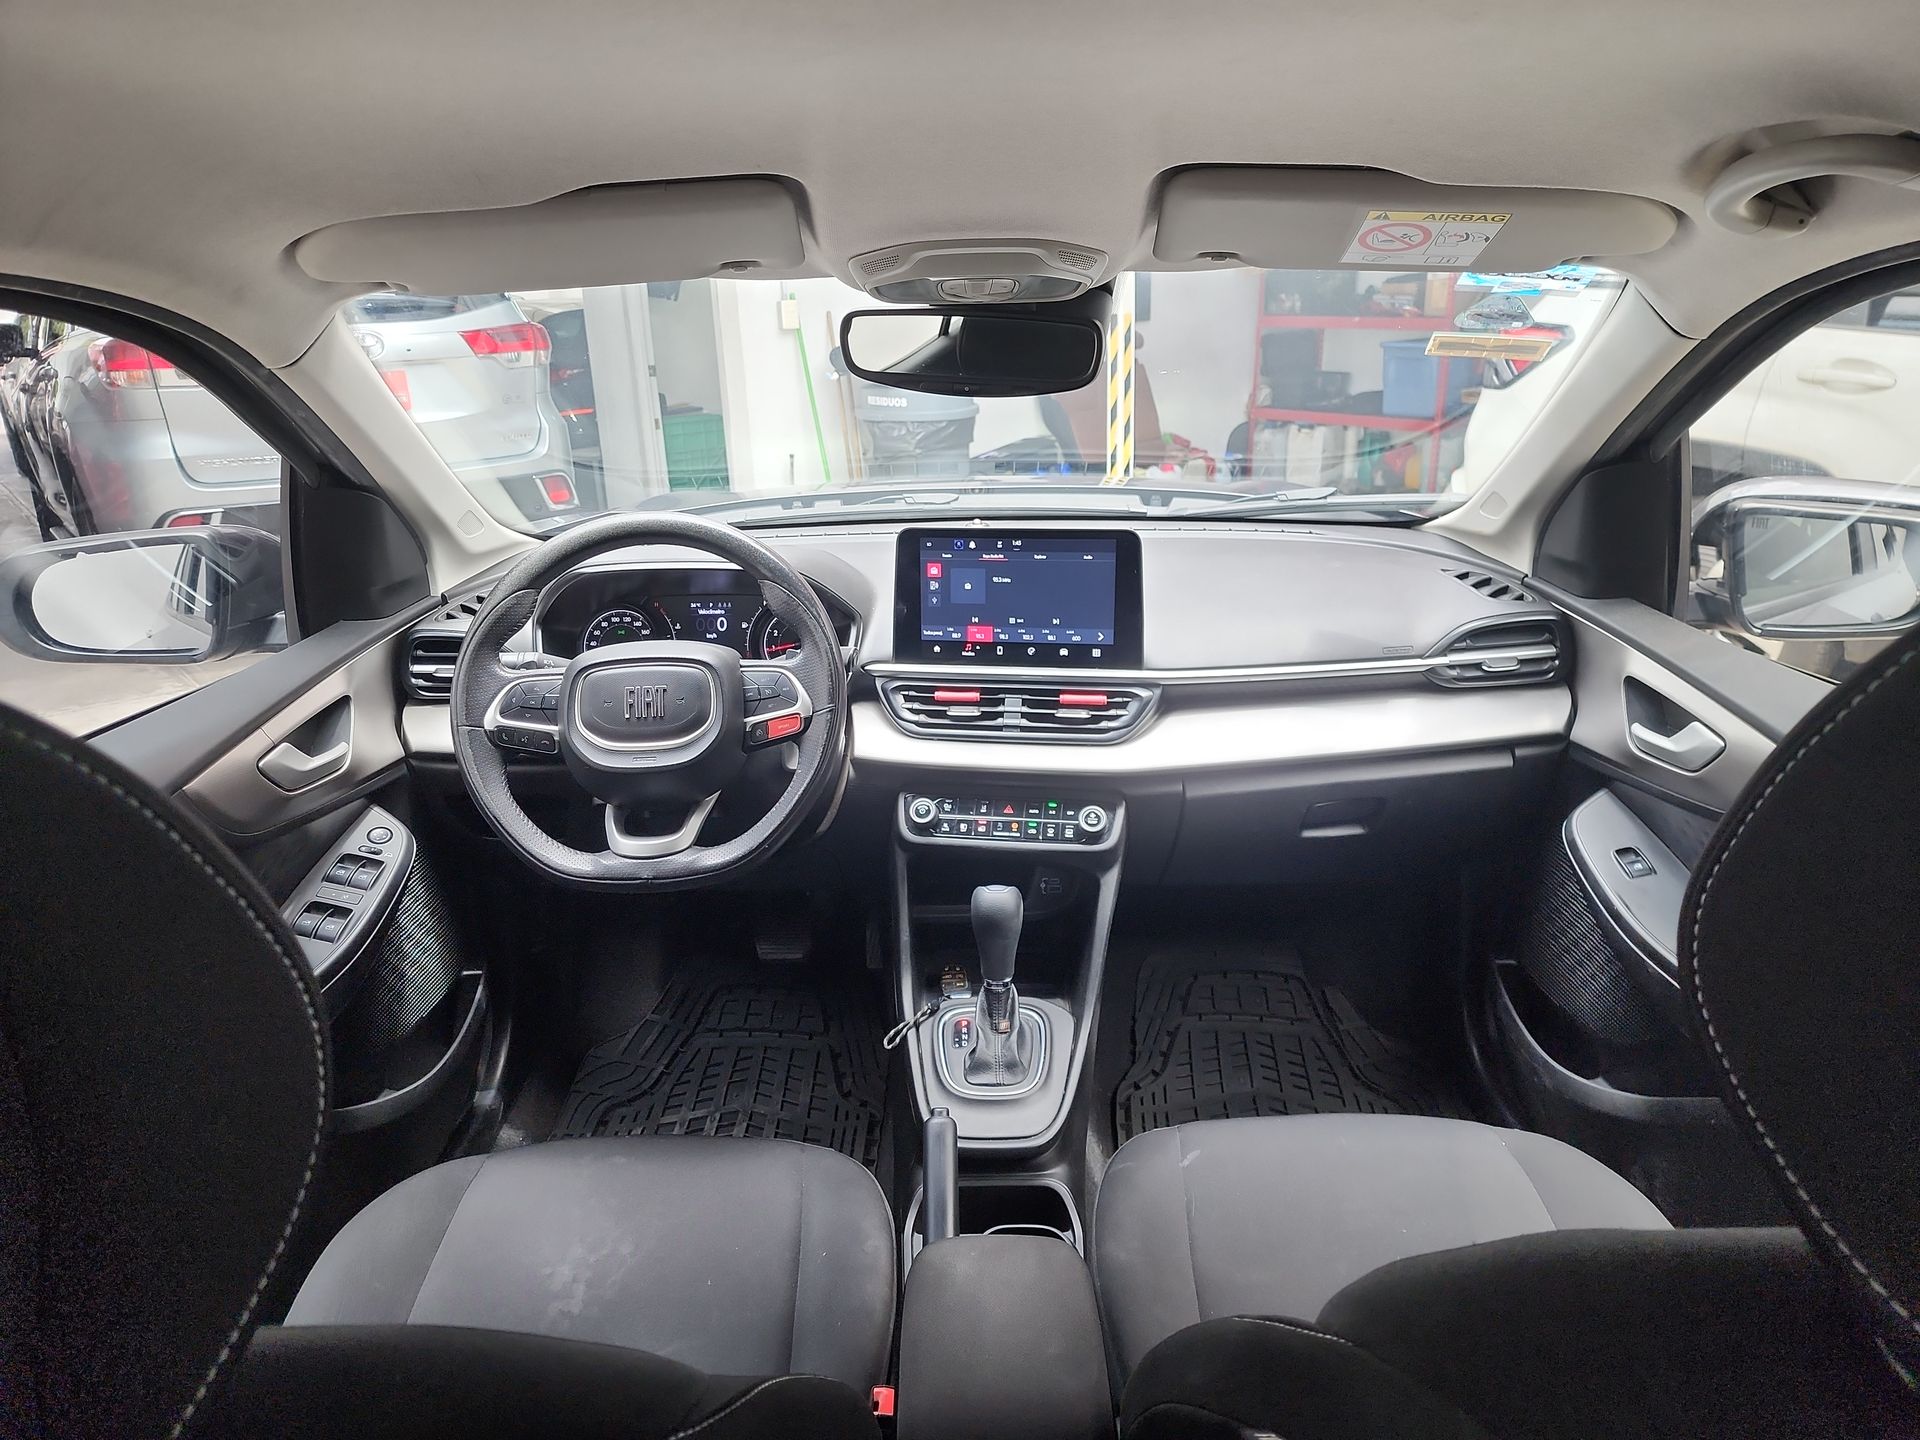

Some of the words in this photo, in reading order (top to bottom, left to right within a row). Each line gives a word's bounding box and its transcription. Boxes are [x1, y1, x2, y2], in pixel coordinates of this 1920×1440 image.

[1422, 213, 1507, 222] AIRBAG
[868, 395, 908, 408] RESIDUOS
[624, 684, 667, 719] FIAT
